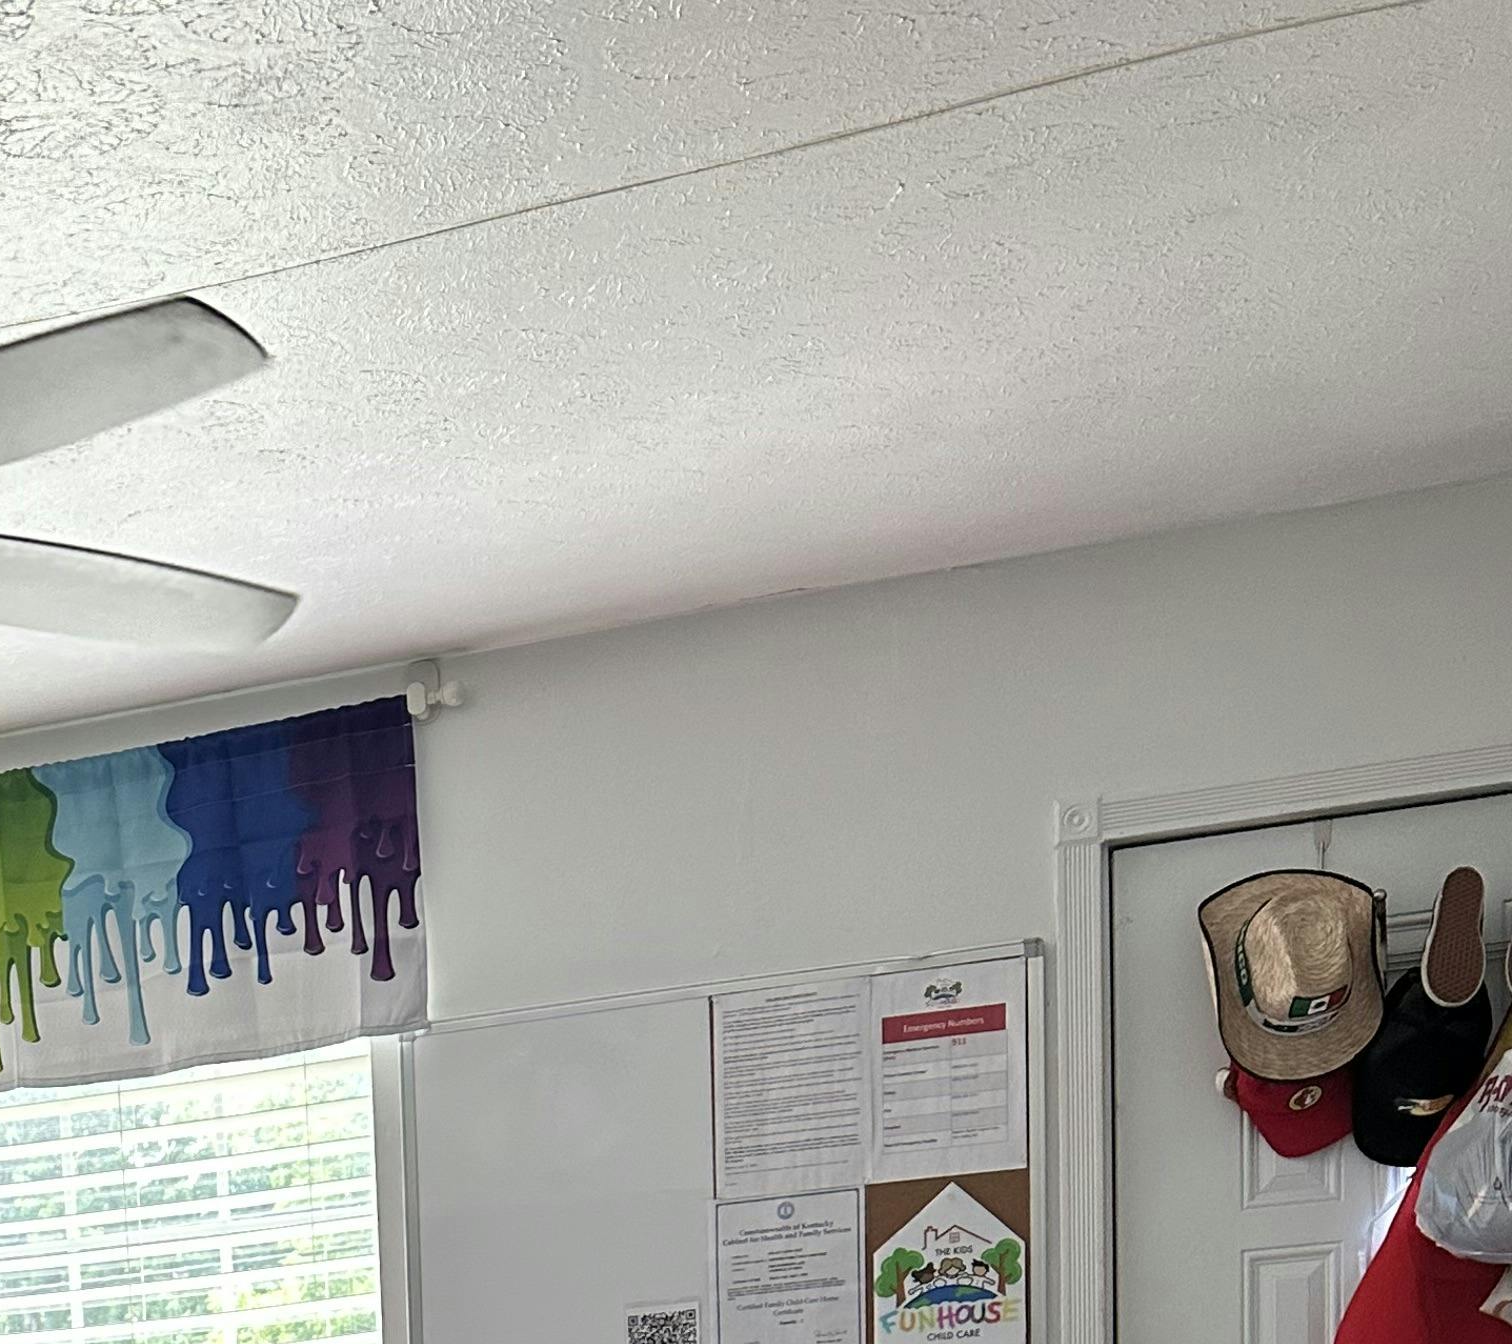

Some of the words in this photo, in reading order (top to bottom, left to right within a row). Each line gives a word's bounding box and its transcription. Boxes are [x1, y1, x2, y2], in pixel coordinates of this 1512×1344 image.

[953, 1245, 973, 1255] KIDS
[927, 1330, 954, 1341] CHILD
[956, 1328, 981, 1339] CARE
